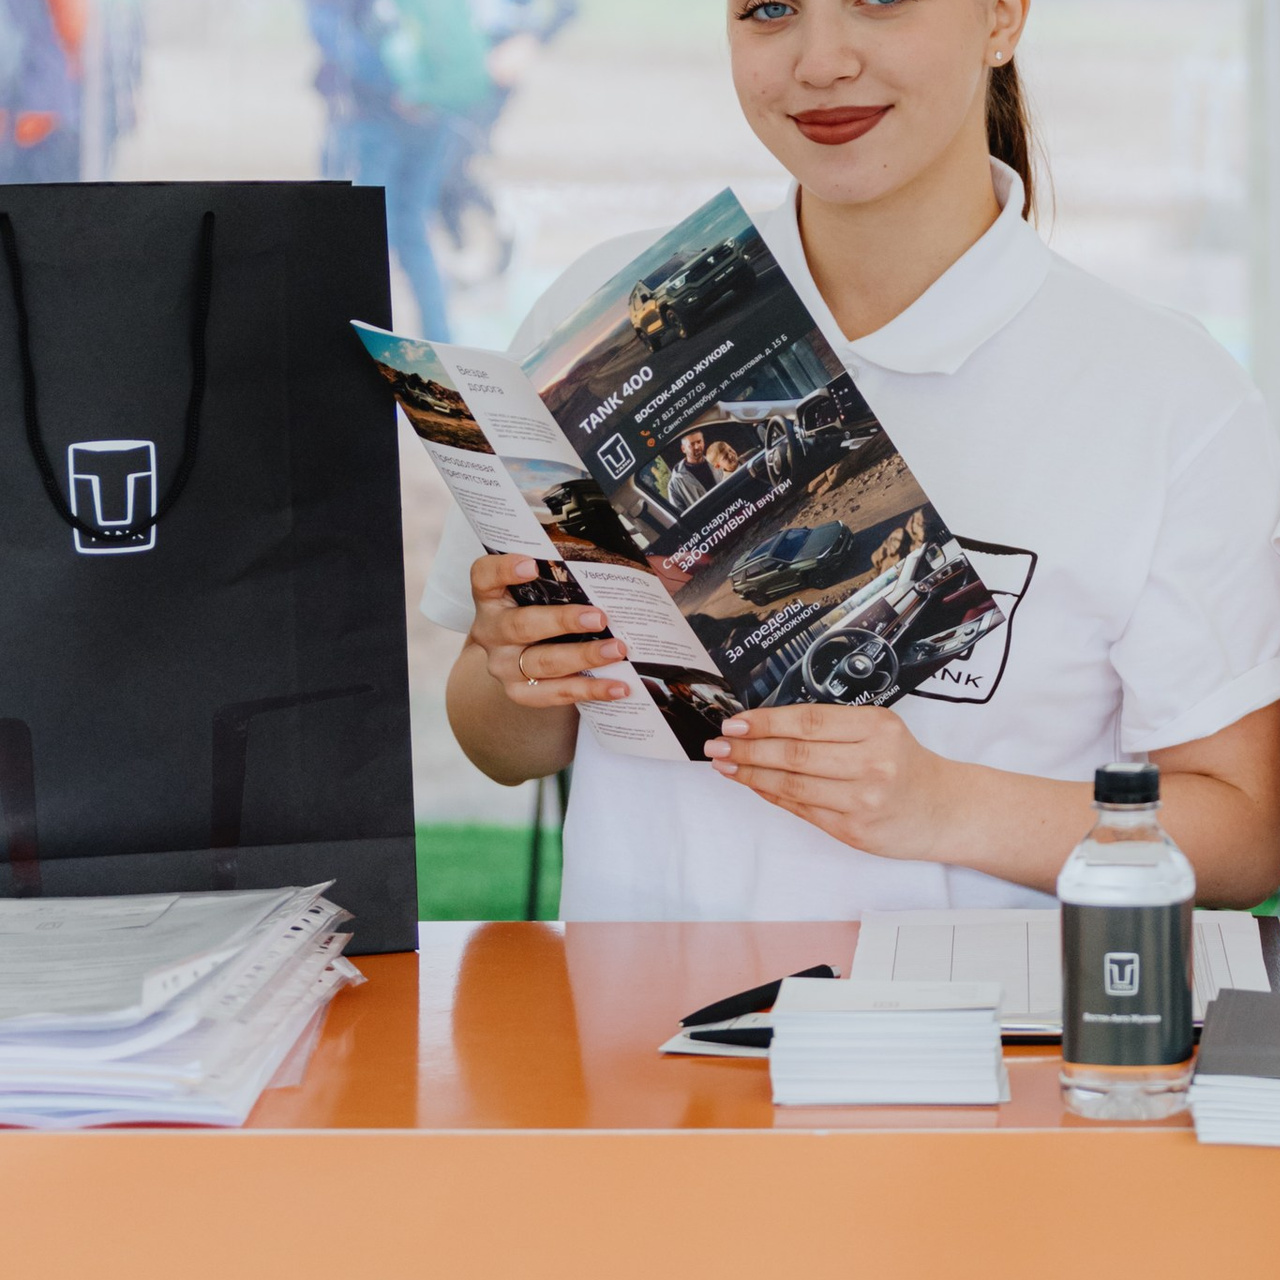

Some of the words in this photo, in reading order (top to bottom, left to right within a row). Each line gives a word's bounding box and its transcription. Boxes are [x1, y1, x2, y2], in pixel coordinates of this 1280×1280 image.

[579, 391, 624, 434] TANK
[622, 366, 653, 397] 400
[634, 370, 694, 423] ВОСТОК-АВТО
[693, 340, 734, 374] ЖУКОВА
[652, 418, 662, 429] +7
[661, 406, 675, 421] 812
[674, 396, 688, 410] 703
[686, 387, 697, 401] 77
[695, 382, 706, 393] 03
[663, 387, 721, 434] Санкт-Петербург,
[719, 378, 731, 389] ул.
[730, 353, 765, 381] Портовая,
[772, 339, 783, 349] 15
[662, 532, 702, 570] Строгий
[701, 498, 747, 536] снаружи,
[678, 502, 757, 572] заботливый
[756, 478, 793, 509] внутри
[580, 569, 650, 587] Уверенность
[725, 645, 745, 663] За
[743, 598, 804, 648] пределы
[761, 602, 820, 649] возможного
[873, 684, 900, 707] время
